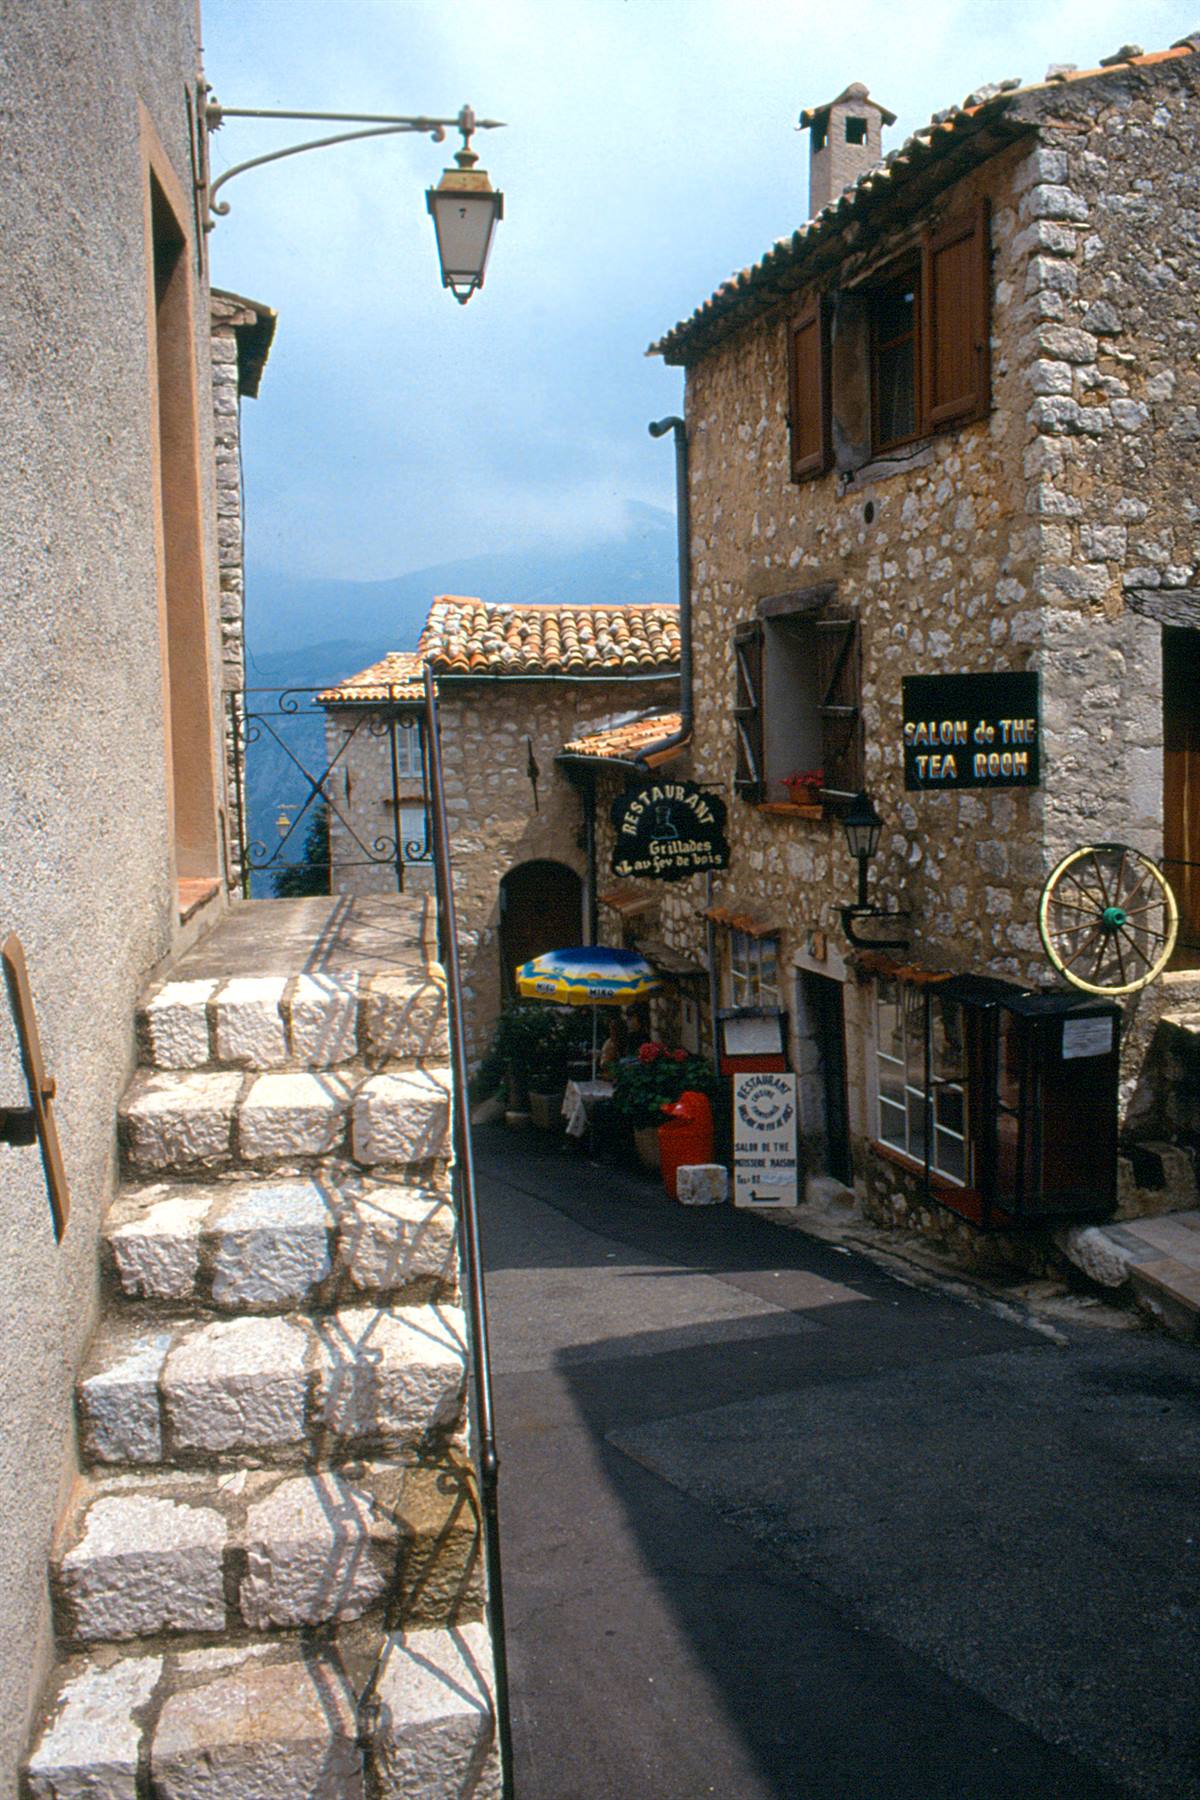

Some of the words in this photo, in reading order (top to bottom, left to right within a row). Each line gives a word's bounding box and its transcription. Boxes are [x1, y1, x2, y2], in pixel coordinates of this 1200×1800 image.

[904, 720, 968, 746] SALON
[973, 720, 995, 744] de
[999, 718, 1036, 744] THE
[915, 754, 958, 779] TEA
[973, 751, 1029, 778] ROOM
[622, 785, 715, 836] RESTAURANT
[649, 840, 712, 855] Grillades
[693, 853, 722, 866] bois
[737, 1075, 792, 1100] RESTAURANT
